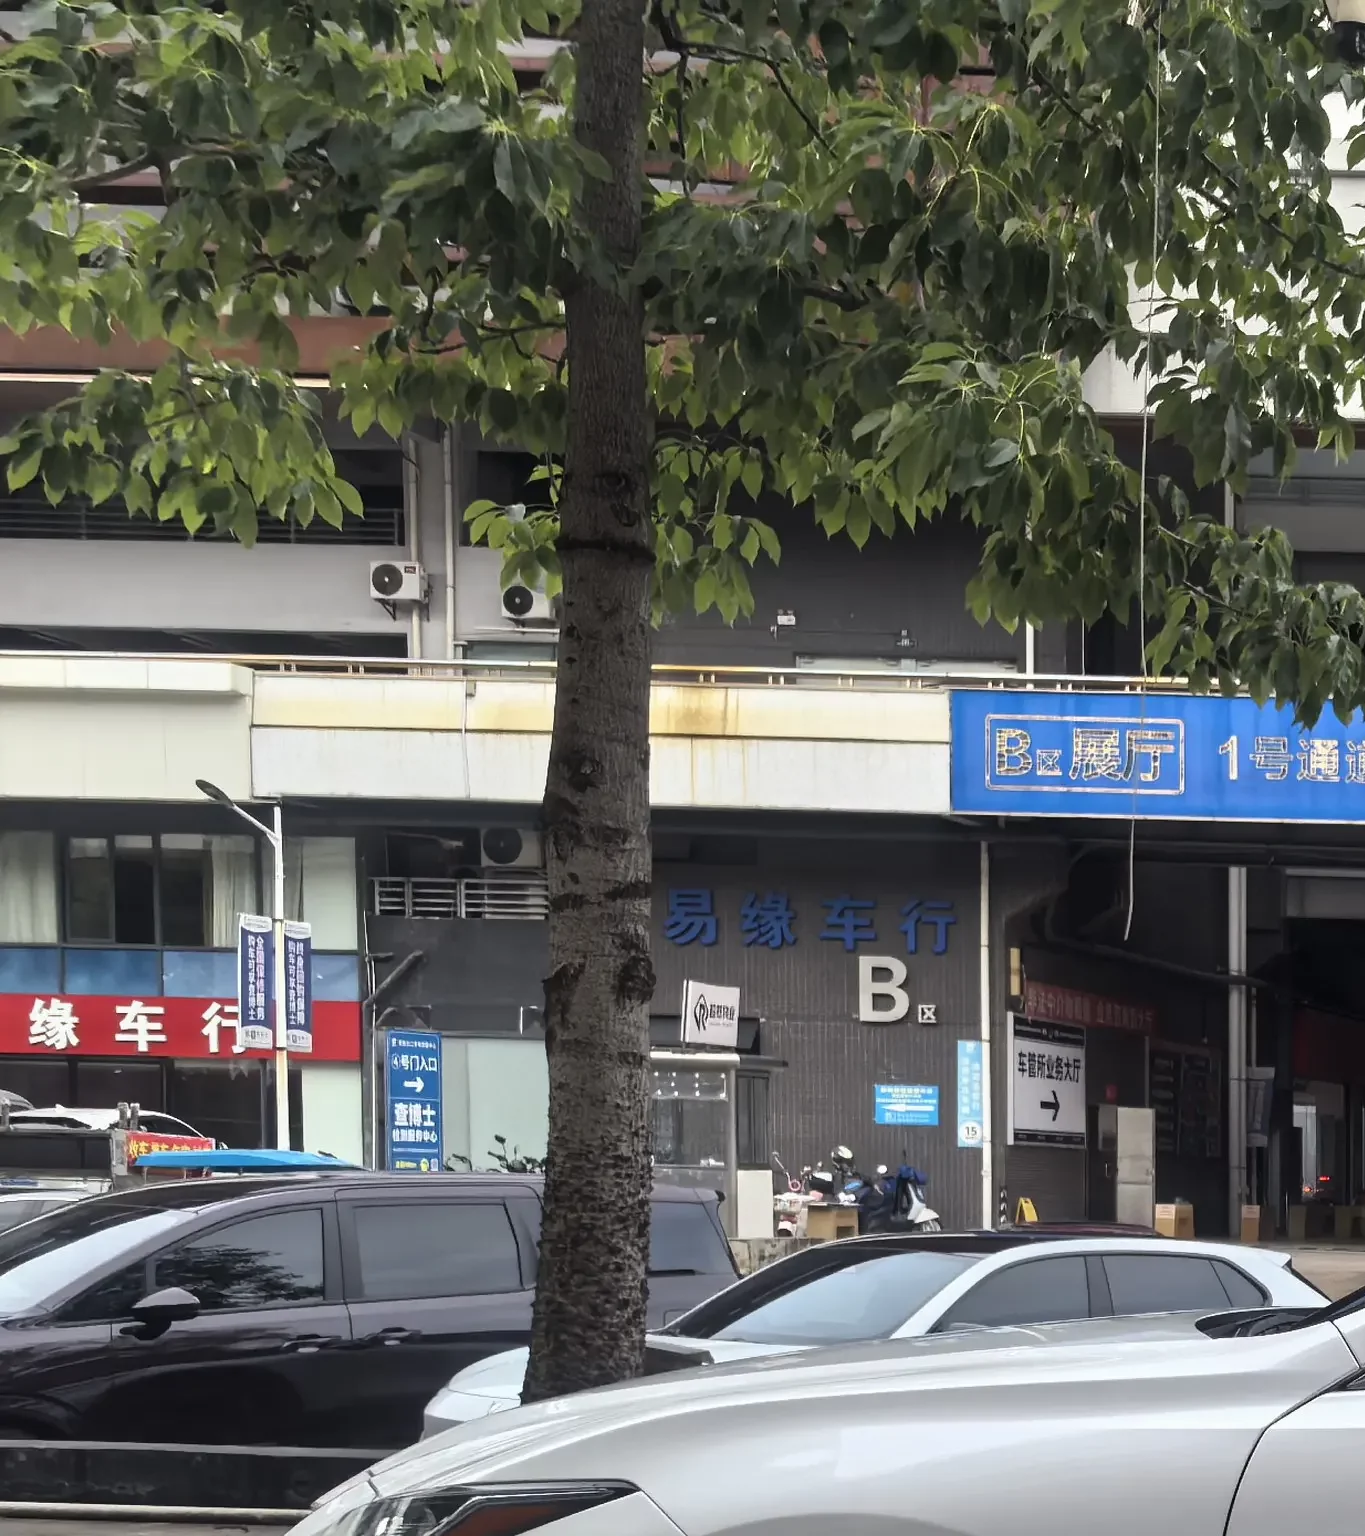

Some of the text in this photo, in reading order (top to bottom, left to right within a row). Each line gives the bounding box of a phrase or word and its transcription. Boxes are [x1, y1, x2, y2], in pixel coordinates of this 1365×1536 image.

[995, 727, 1176, 783] B区展厅
[663, 888, 958, 955] 易缘车行
[28, 997, 246, 1054] 缘车行
[1017, 1051, 1081, 1083] 车管所业务大厅
[394, 1102, 437, 1127] 查博士
